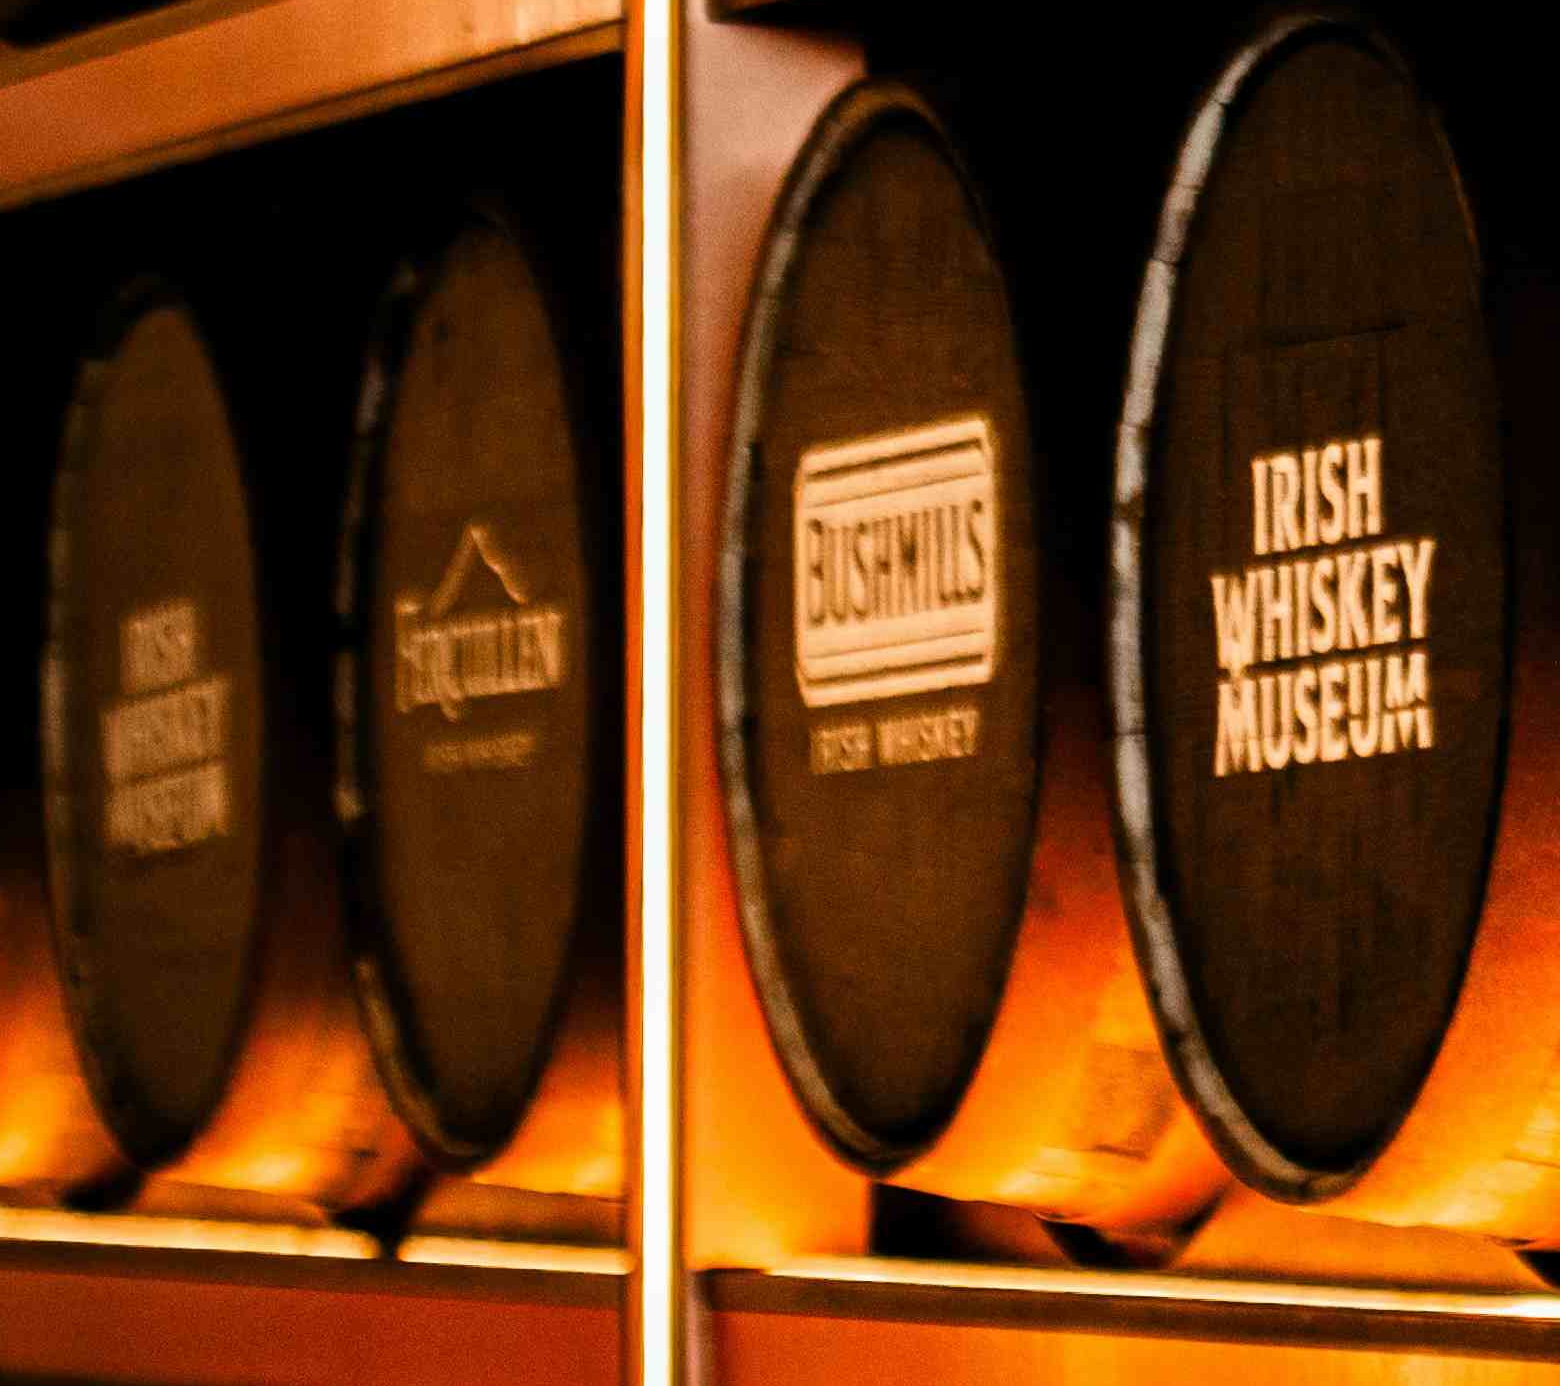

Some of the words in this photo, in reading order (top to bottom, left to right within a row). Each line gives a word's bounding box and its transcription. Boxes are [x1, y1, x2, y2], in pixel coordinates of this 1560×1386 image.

[1251, 436, 1384, 556] IRISH
[806, 499, 985, 626] BUSHMILLS
[1210, 538, 1436, 670] WHISKEY
[1214, 649, 1435, 779] MUSEUM
